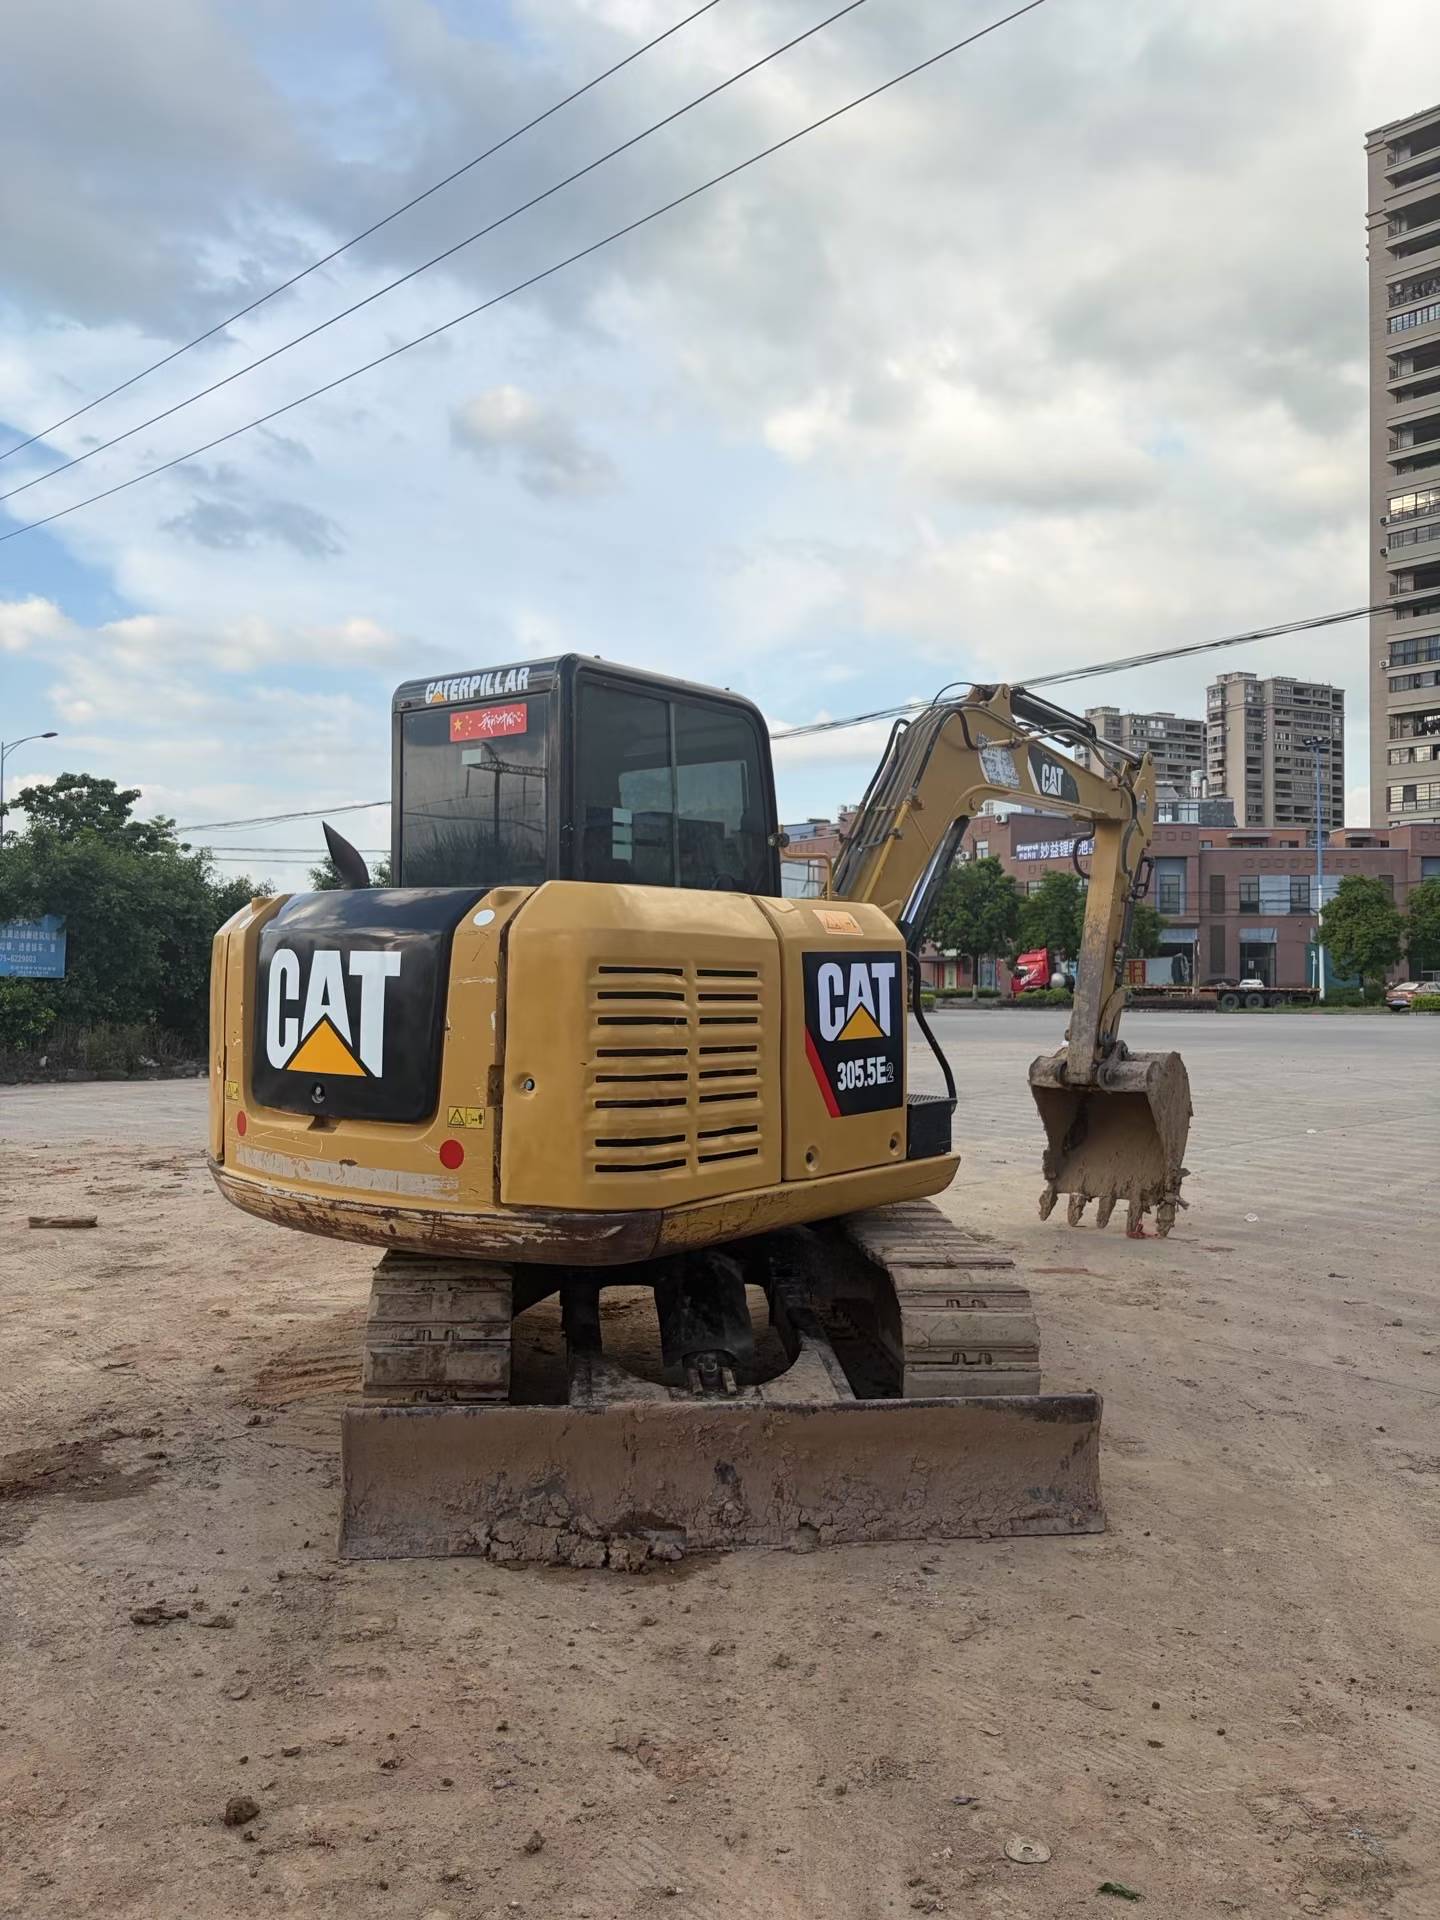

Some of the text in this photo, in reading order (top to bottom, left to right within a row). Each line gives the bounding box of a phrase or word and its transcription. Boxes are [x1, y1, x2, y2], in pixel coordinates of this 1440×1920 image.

[425, 667, 530, 704] CATERPILLAR
[1041, 763, 1064, 796] CAT
[266, 948, 402, 1078] CAT
[817, 962, 896, 1042] CAT
